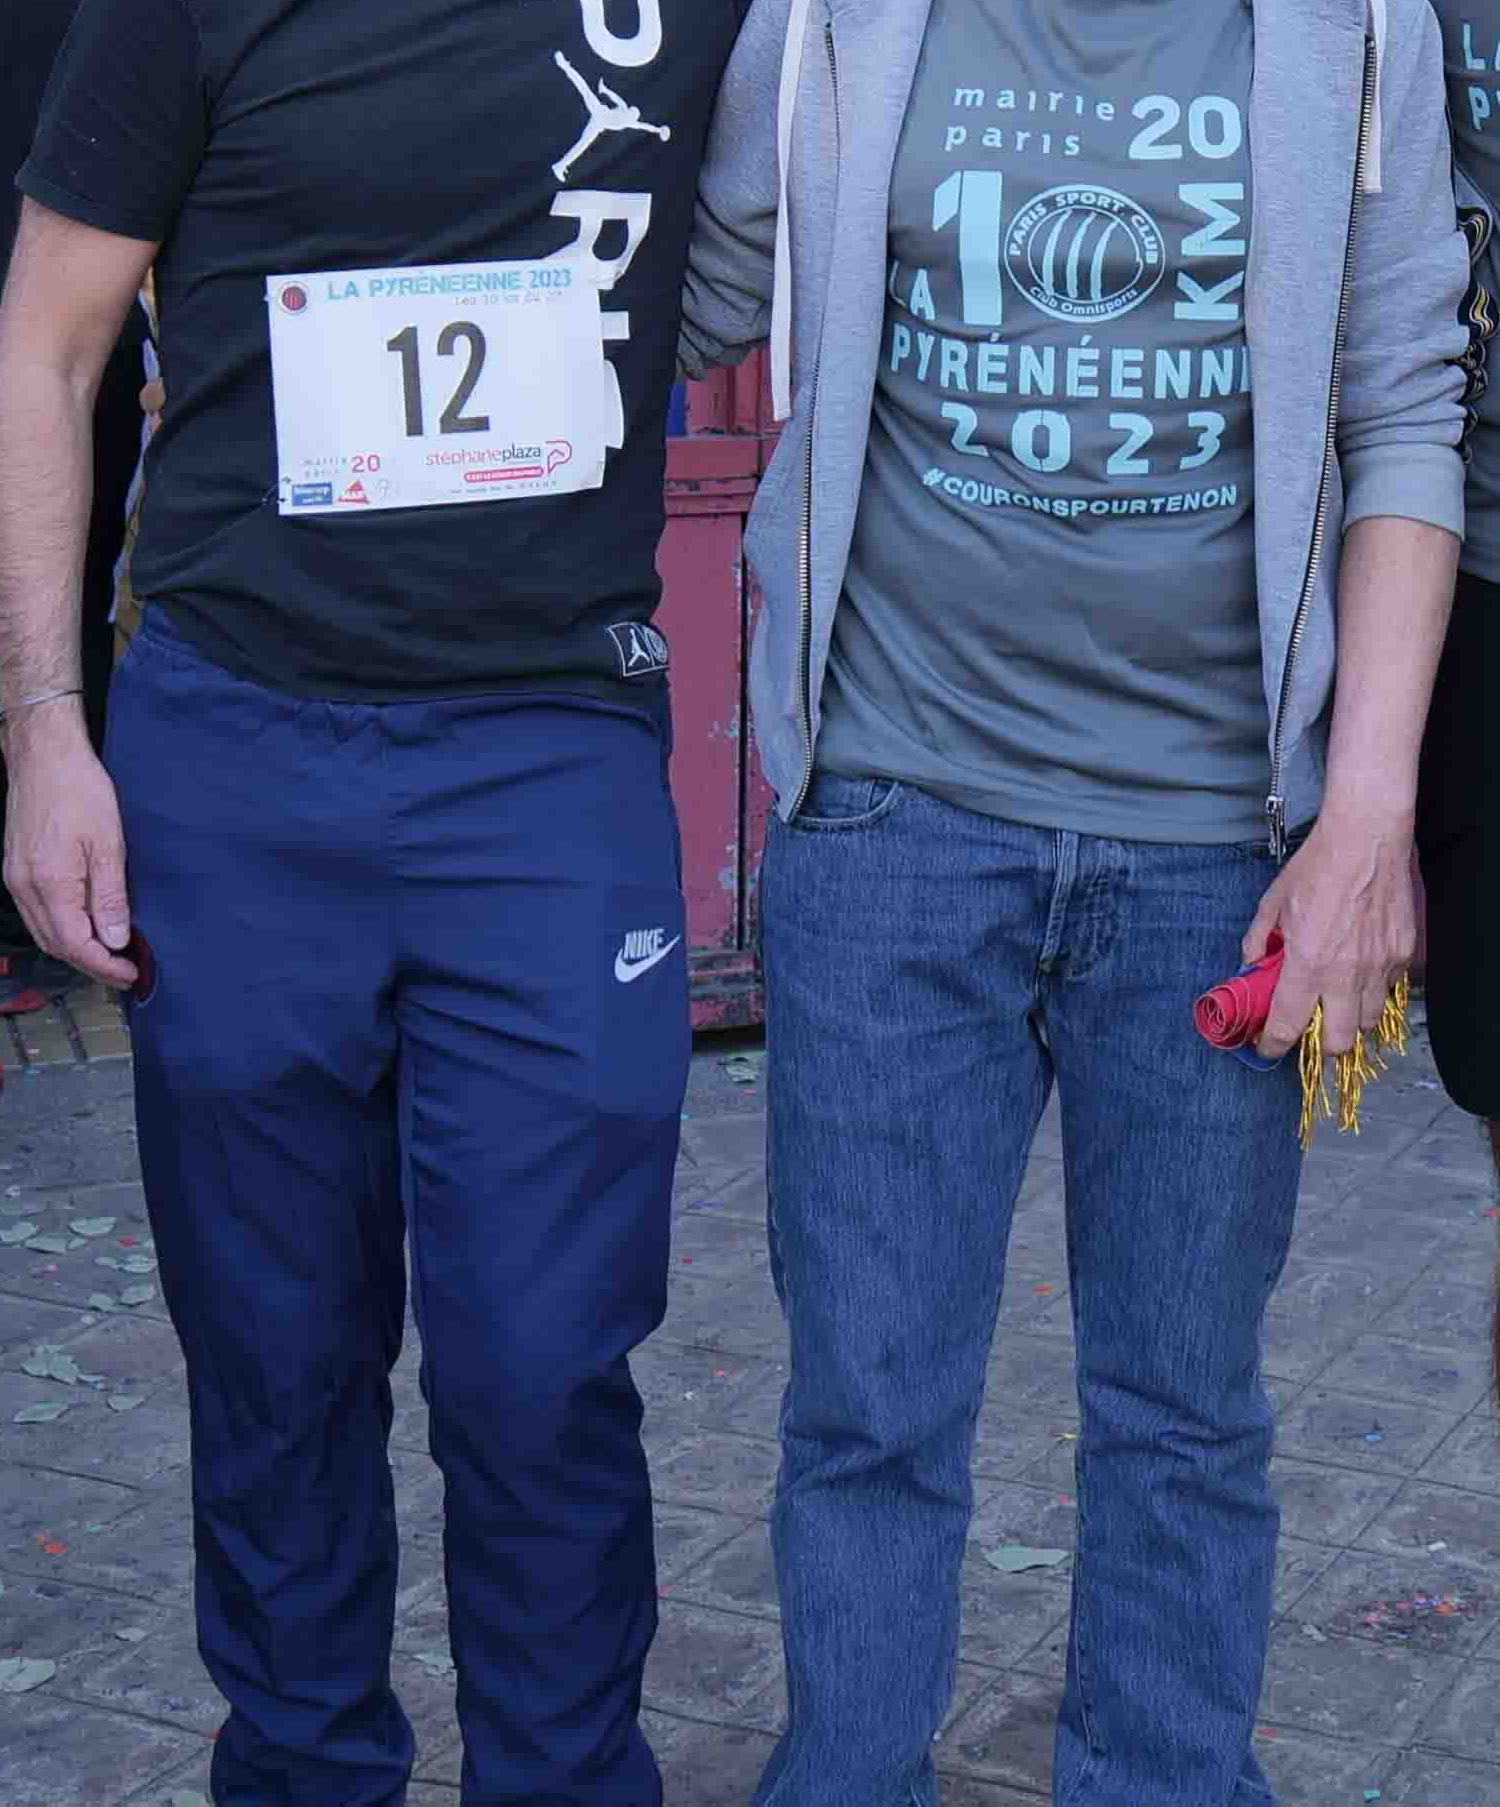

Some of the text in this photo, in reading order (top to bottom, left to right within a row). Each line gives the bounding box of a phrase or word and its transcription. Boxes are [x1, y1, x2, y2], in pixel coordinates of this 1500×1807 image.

[944, 125, 1081, 157] paris
[954, 87, 1242, 160] mairie 20
[1009, 202, 1048, 257] PARIS
[1130, 214, 1158, 264] CLUB
[1174, 182, 1244, 321] KM
[327, 279, 359, 301] LA
[530, 267, 573, 289] 2023
[1030, 286, 1139, 314] Club Omnisports
[386, 320, 491, 436] 12
[352, 453, 381, 473] 20
[940, 401, 1226, 476] 2023
[922, 467, 1237, 517] #COURONSPOURTENON
[624, 928, 665, 961] NIKE
